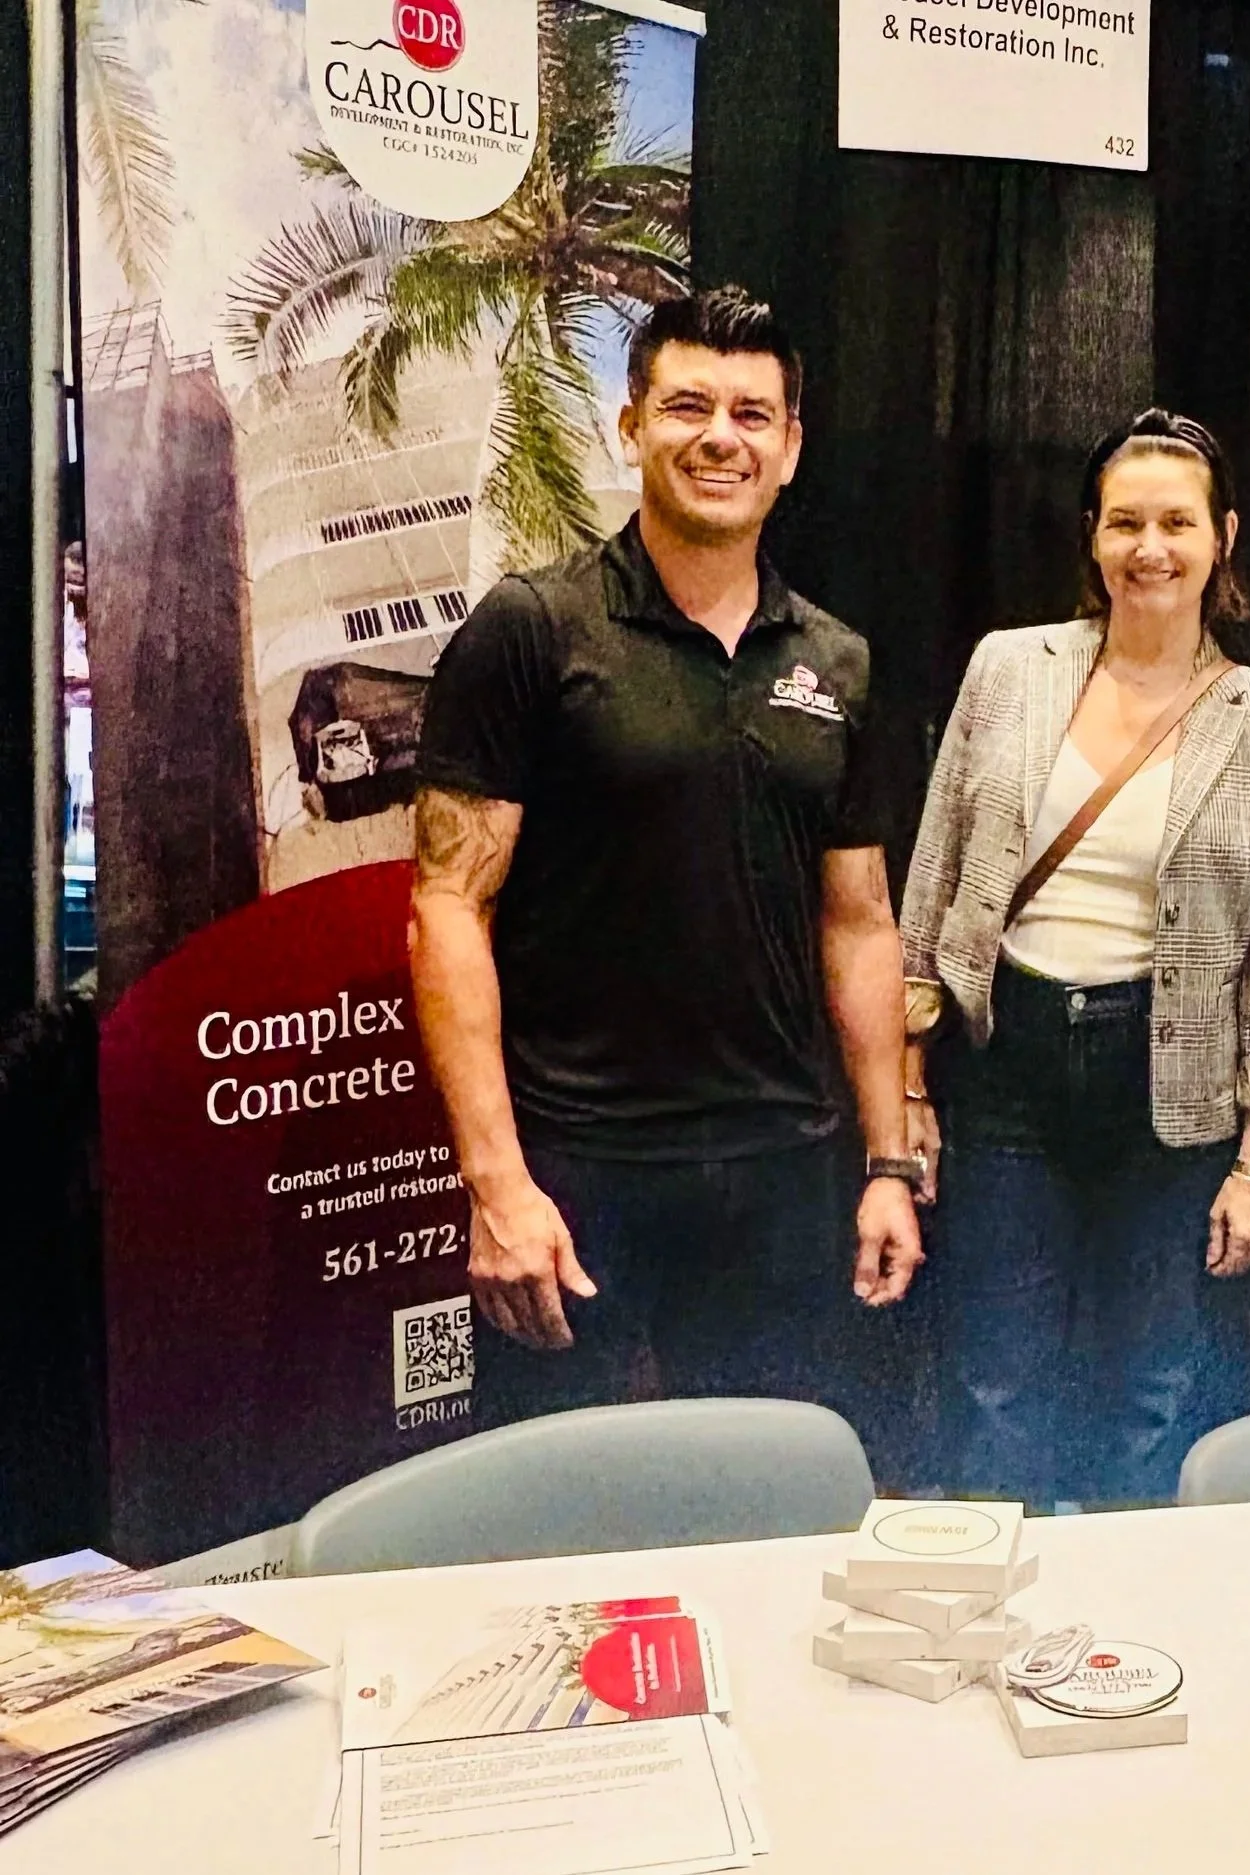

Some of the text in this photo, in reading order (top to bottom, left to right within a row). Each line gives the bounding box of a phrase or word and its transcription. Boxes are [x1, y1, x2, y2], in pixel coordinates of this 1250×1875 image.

[399, 5, 462, 50] CDR
[882, 14, 1105, 69] & Restoration Inc.
[325, 61, 529, 140] CAROUSEL
[1105, 135, 1135, 157] 432
[197, 991, 405, 1060] Complex
[206, 1057, 416, 1126] Concrete
[347, 1159, 367, 1179] us
[372, 1147, 426, 1173] today
[429, 1146, 450, 1163] to
[300, 1204, 313, 1220] a
